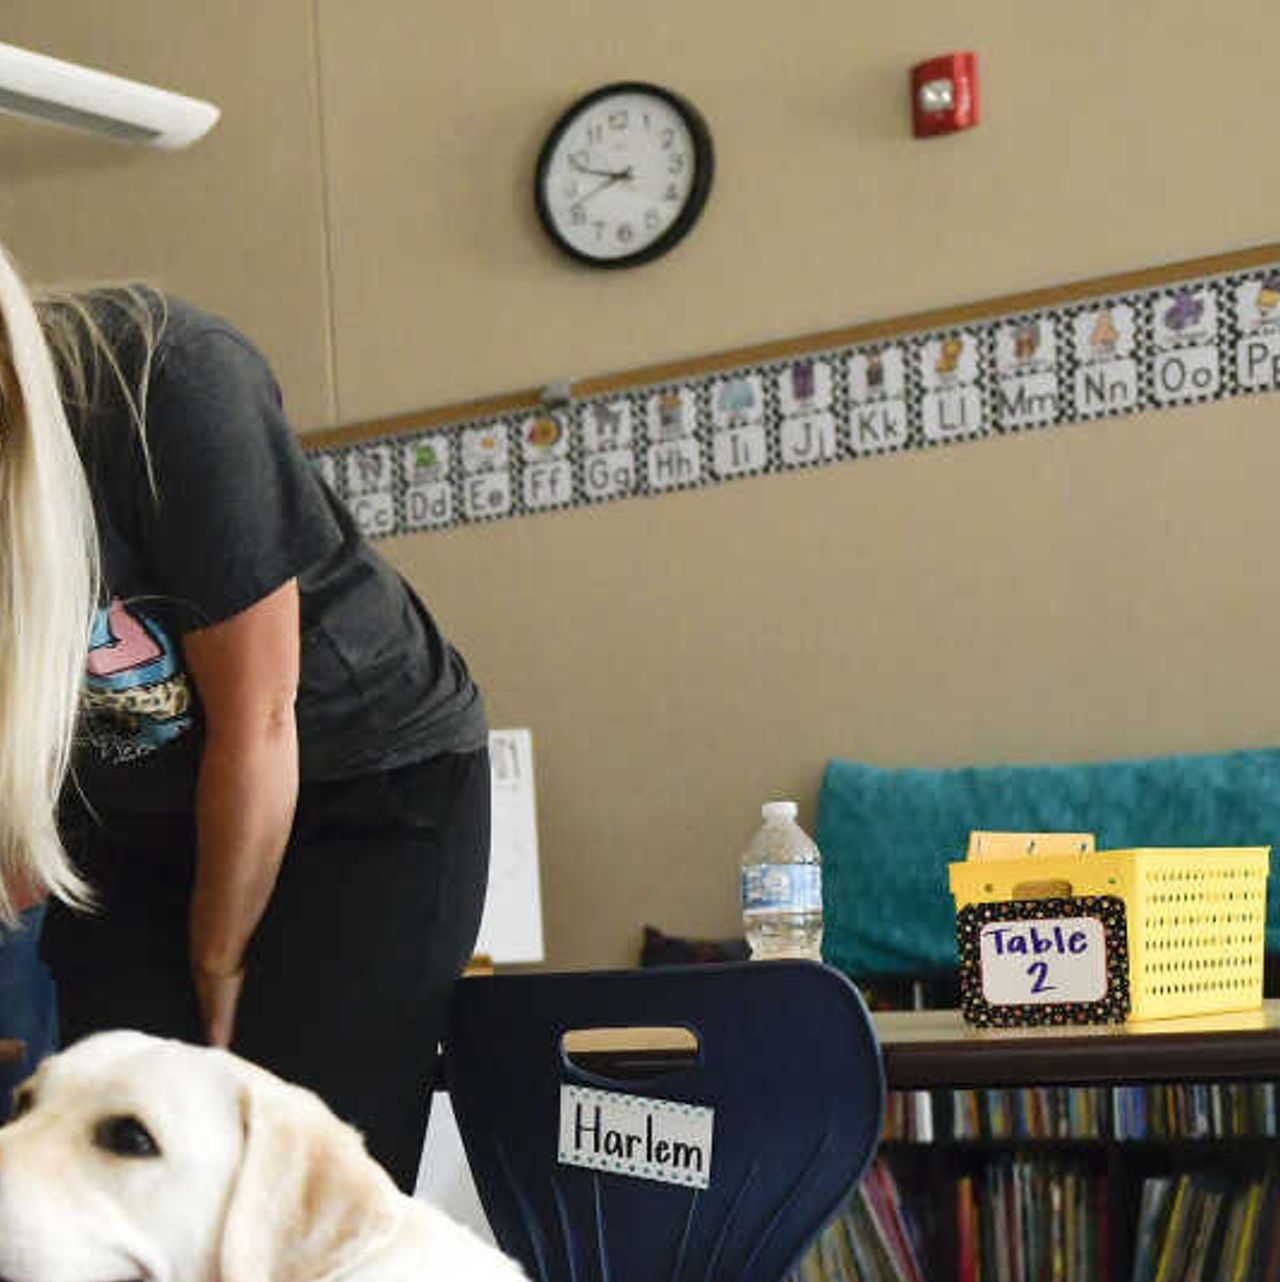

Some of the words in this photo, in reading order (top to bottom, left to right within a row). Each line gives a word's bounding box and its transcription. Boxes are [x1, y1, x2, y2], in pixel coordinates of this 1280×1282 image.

[355, 503, 389, 529] Cc
[411, 491, 446, 521] Dd
[470, 480, 504, 511] Ee
[530, 468, 561, 499] Ff
[589, 458, 631, 489] Gg
[656, 454, 692, 479] Hh
[730, 434, 751, 467] Ii
[858, 410, 899, 443] Kk
[939, 397, 966, 430] Ll
[997, 386, 1057, 421] Mm
[1084, 370, 1128, 405] Nn
[1162, 358, 1213, 392] Oo
[983, 926, 1089, 955] Table
[1027, 961, 1058, 994] 2
[574, 1102, 702, 1172] Harlem
